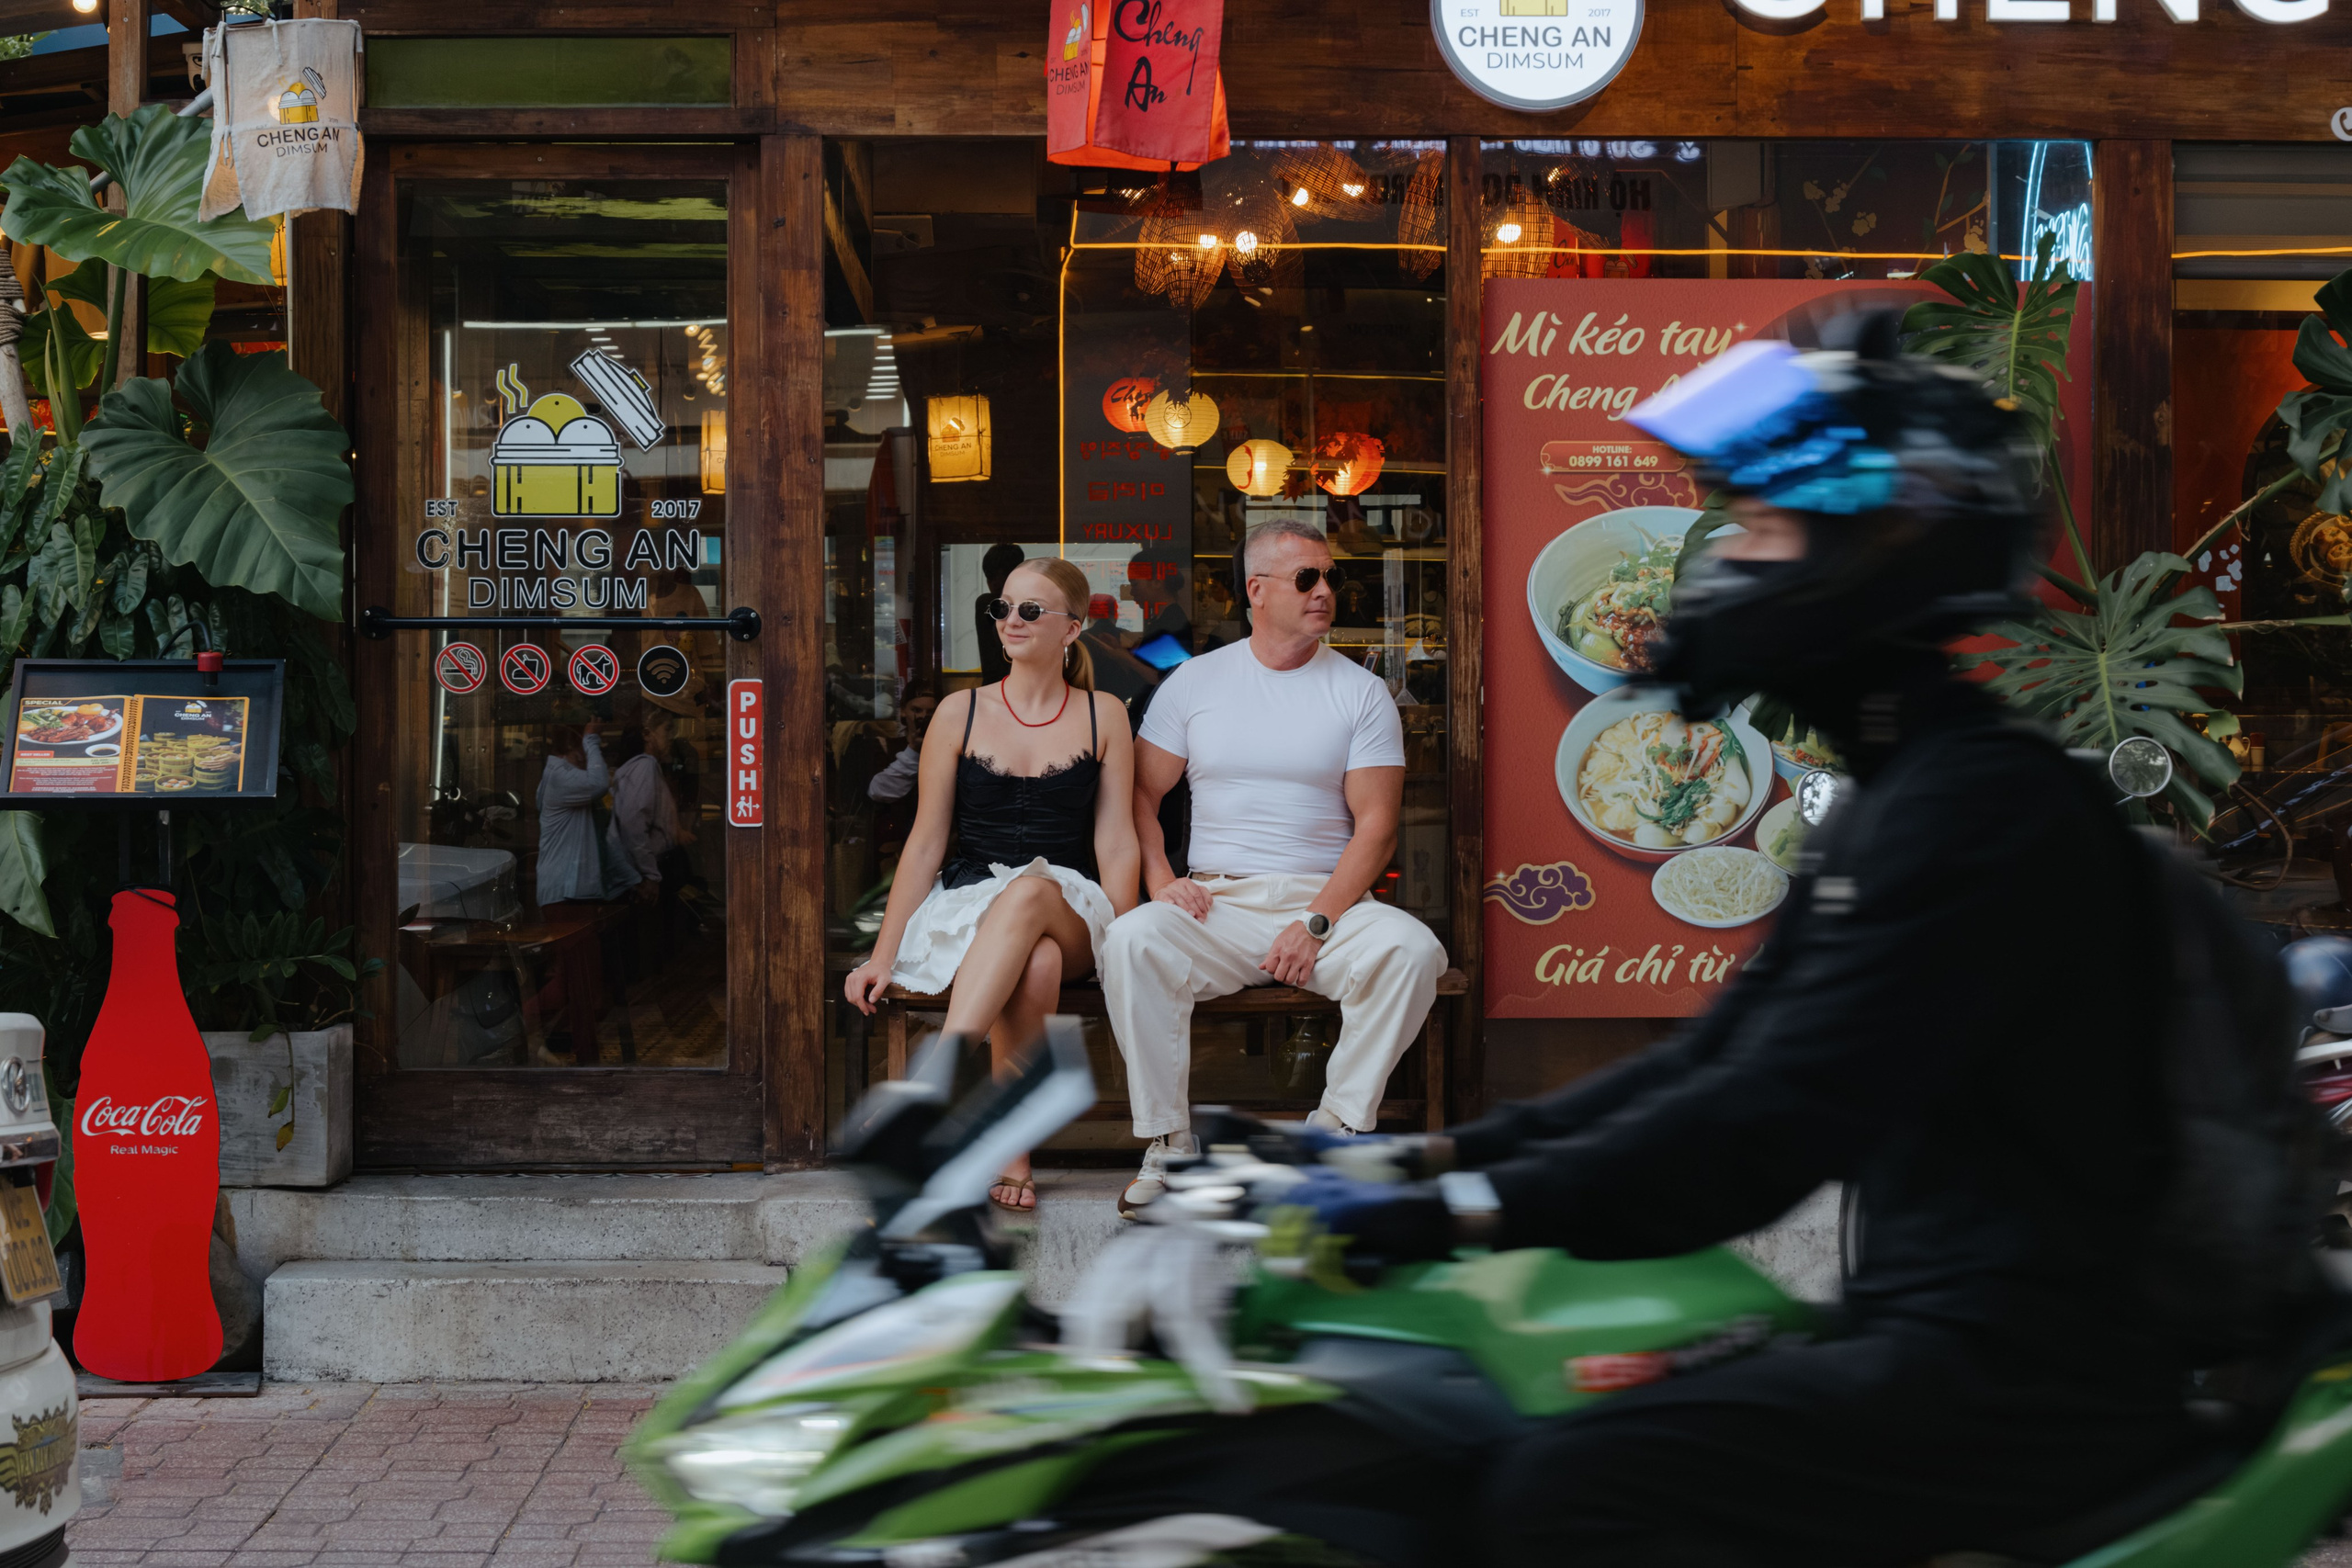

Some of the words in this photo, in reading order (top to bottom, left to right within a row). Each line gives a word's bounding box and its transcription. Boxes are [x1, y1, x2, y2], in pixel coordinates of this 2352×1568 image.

[1460, 8, 1480, 17] EST
[1588, 8, 1611, 17] 2017
[1458, 26, 1563, 48] CHENG
[1570, 26, 1611, 48] AN
[1487, 52, 1584, 69] DIMSUM
[1049, 64, 1079, 83] CHENG
[1124, 56, 1169, 112] An
[256, 127, 320, 148] CHENG
[322, 126, 340, 142] AN
[1489, 310, 1563, 357] Mì
[1568, 311, 1645, 356] kéo
[1659, 321, 1734, 367] tay
[1523, 373, 1639, 422] Cheng
[935, 444, 959, 452] CHENG
[1592, 446, 1633, 454] HOTLINE:
[1569, 456, 1602, 468] 0899
[1605, 456, 1630, 468] 161
[1634, 456, 1658, 468] 649
[425, 500, 458, 517] EST
[651, 500, 702, 519] 2017
[416, 528, 613, 571] CHENG
[625, 528, 701, 571] AN
[468, 577, 648, 610] DIMSUM
[739, 691, 757, 791] PUSH
[1534, 943, 1610, 987] Giá
[1614, 943, 1685, 985] chỉ
[1689, 944, 1736, 984] từ
[81, 1096, 209, 1136] Coca-Cola
[110, 1145, 139, 1155] Real
[141, 1145, 179, 1156] Magic
